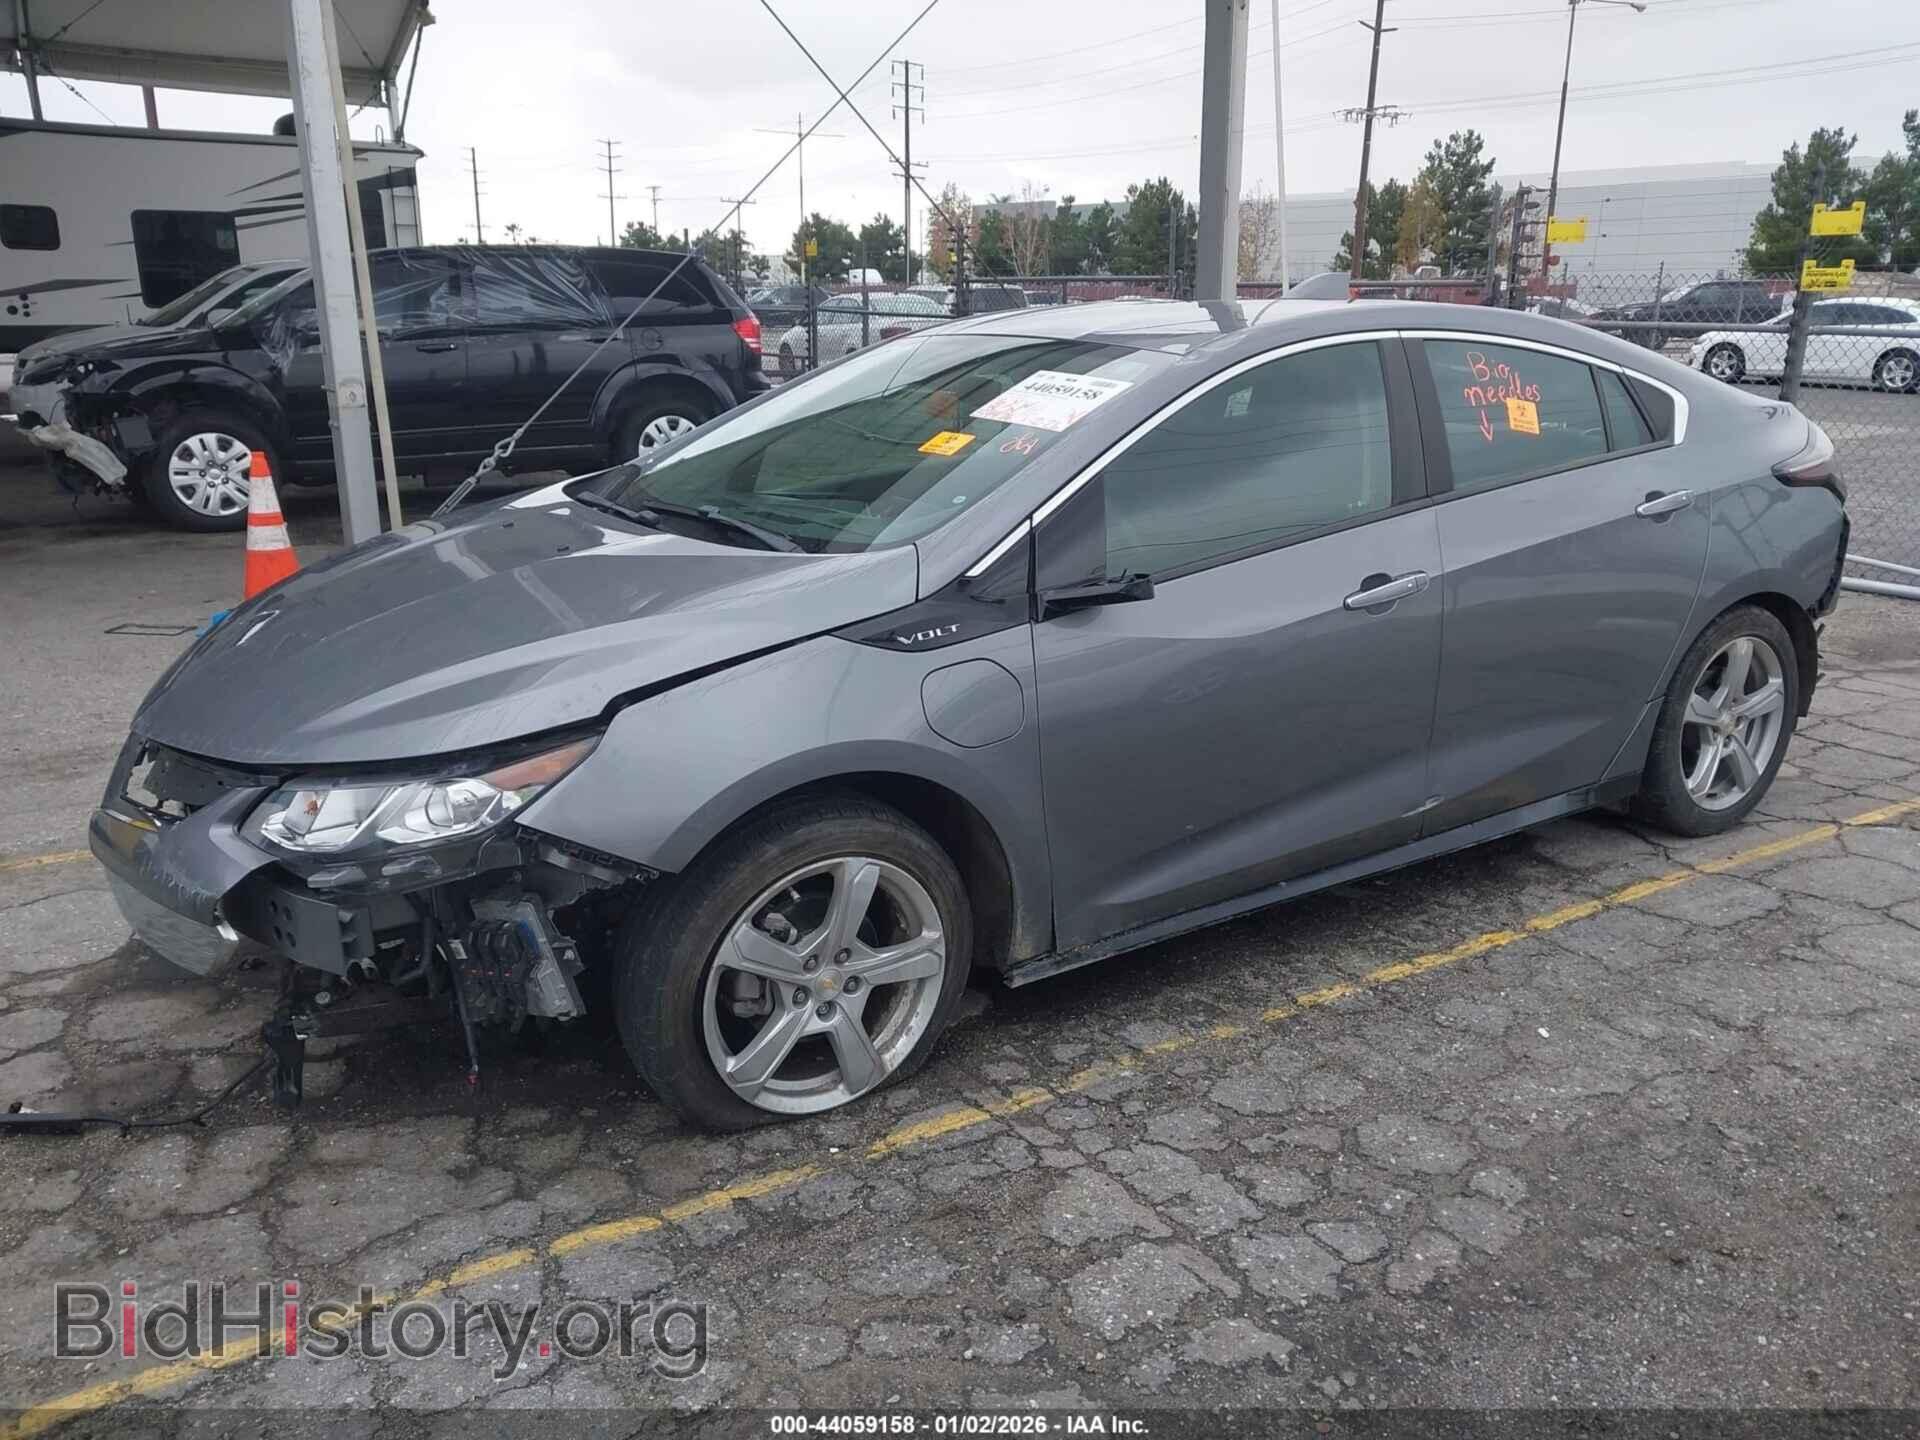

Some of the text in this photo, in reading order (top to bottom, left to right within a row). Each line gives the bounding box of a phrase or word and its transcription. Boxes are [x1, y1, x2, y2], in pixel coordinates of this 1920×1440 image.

[1467, 351, 1511, 382] Bio
[1024, 381, 1103, 401] 44059158
[896, 623, 961, 645] VOLT
